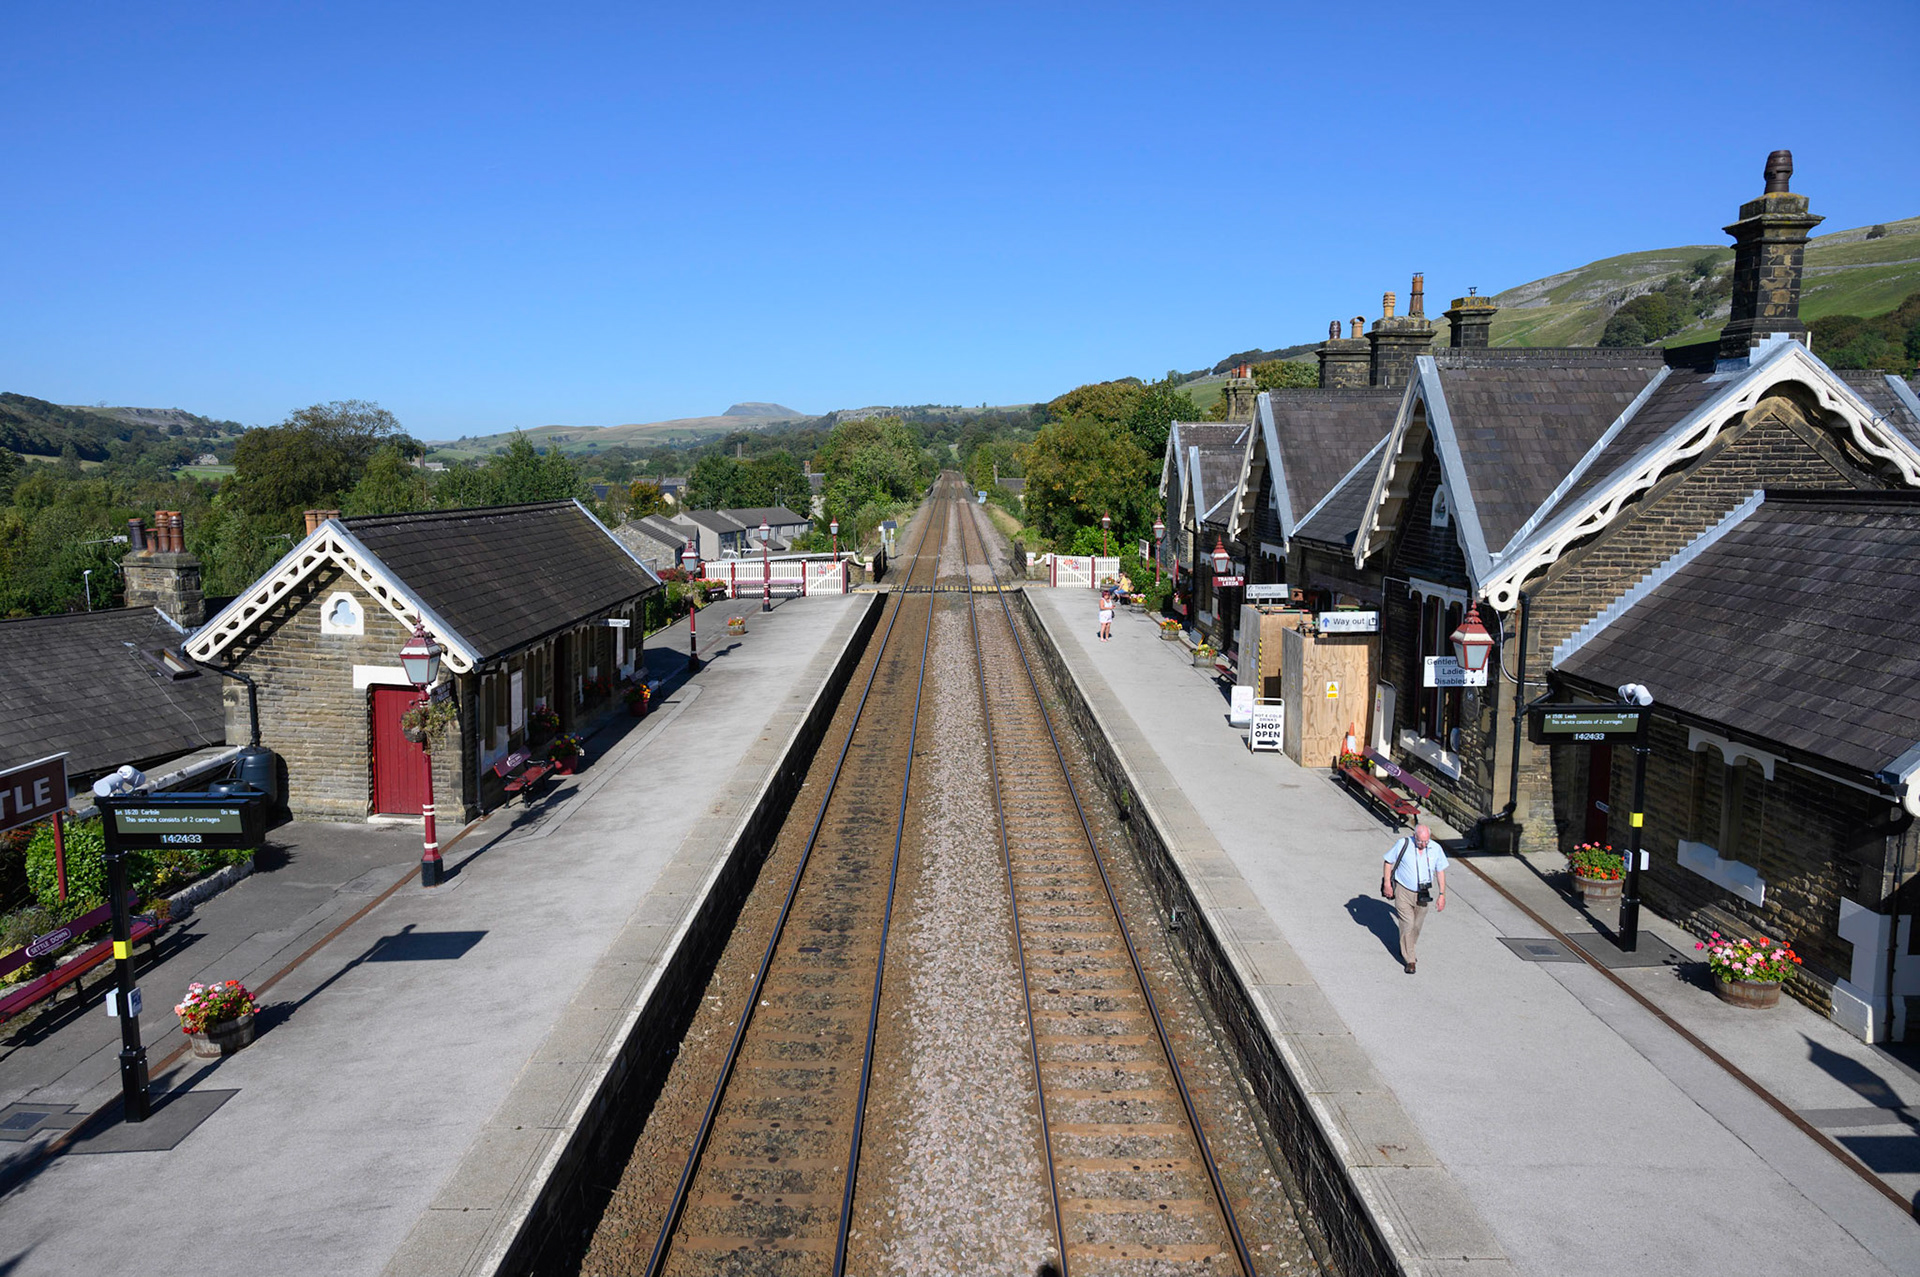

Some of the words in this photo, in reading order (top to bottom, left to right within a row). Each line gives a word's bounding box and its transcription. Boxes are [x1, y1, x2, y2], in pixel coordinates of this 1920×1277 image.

[1427, 658, 1458, 666] Gentlem
[1434, 677, 1468, 685] Disabled
[1256, 722, 1281, 730] SHOP
[1255, 730, 1281, 738] OPEN
[194, 817, 221, 825] carriages
[162, 834, 202, 844] 14:24:33
[30, 940, 50, 954] SETTLE
[50, 930, 68, 944] DOWN
